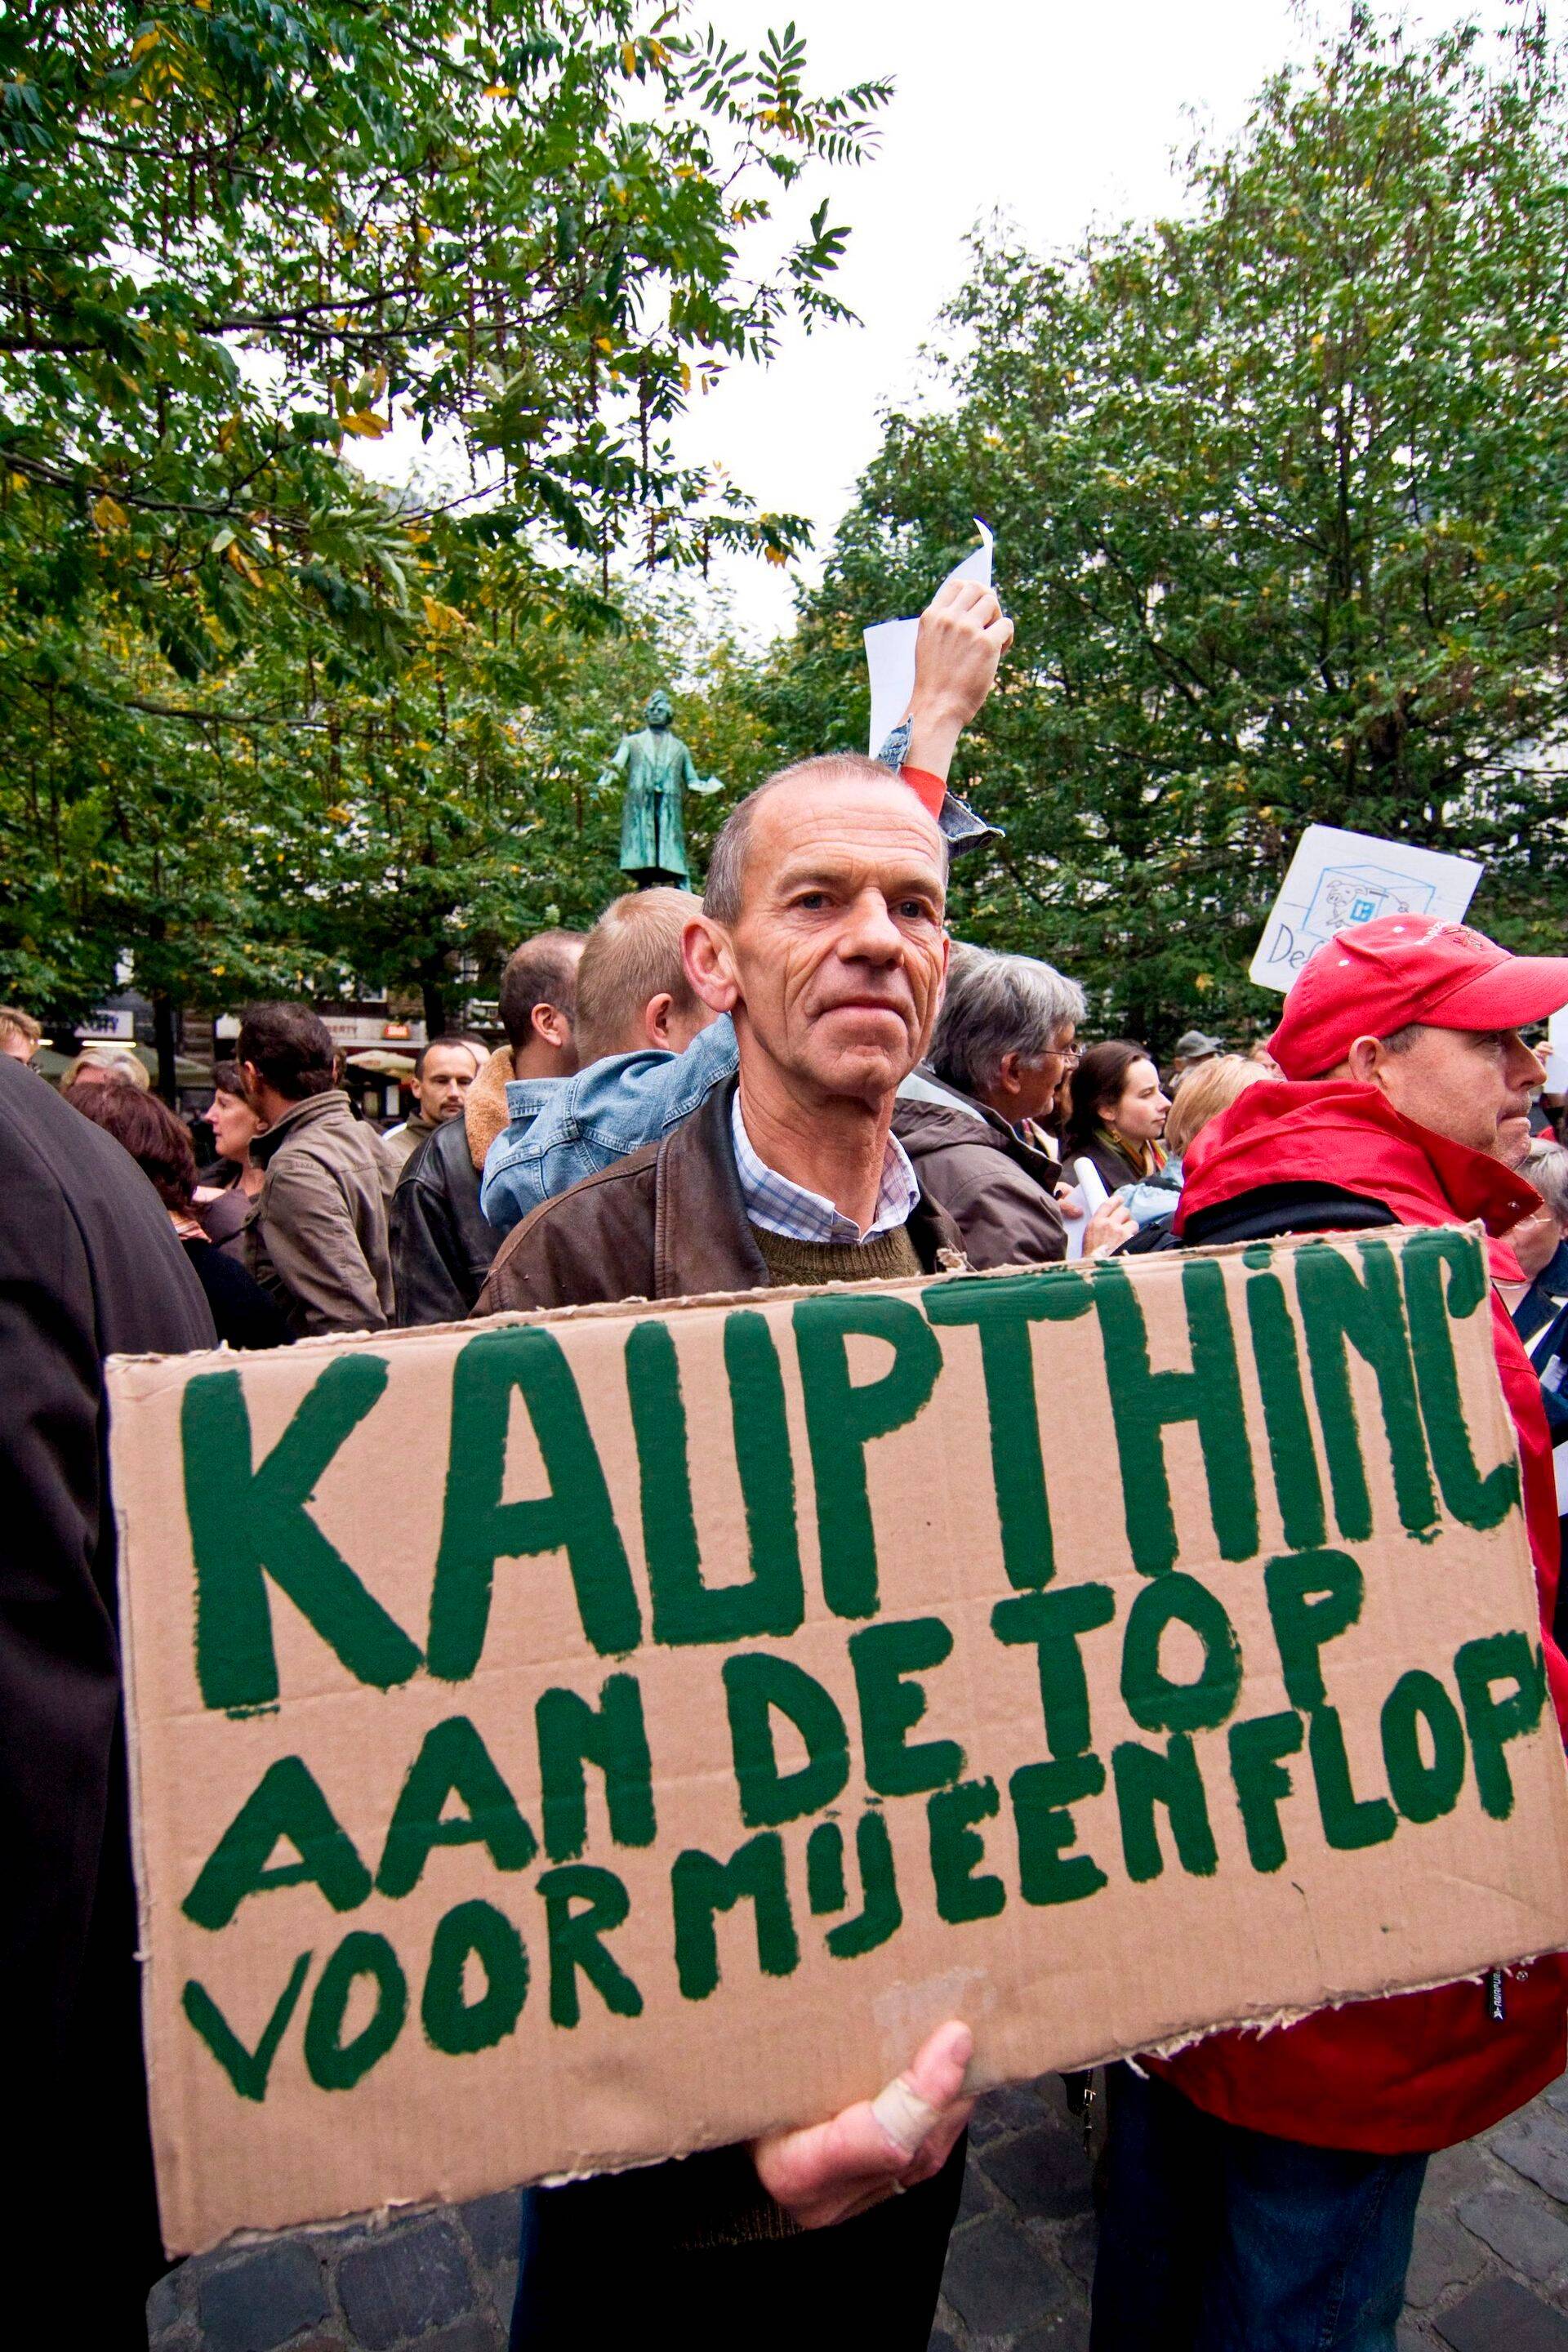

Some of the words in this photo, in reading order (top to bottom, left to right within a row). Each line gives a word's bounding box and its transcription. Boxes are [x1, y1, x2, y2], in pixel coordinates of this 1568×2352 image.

[183, 1673, 657, 1930] AAN
[724, 1617, 967, 1829] DE
[991, 1549, 1365, 1758] TOP
[183, 1863, 643, 2101] VOOR
[670, 1798, 902, 2002] MIJ
[927, 1733, 1219, 1924] EEN
[1229, 1630, 1548, 1873] FLOP
